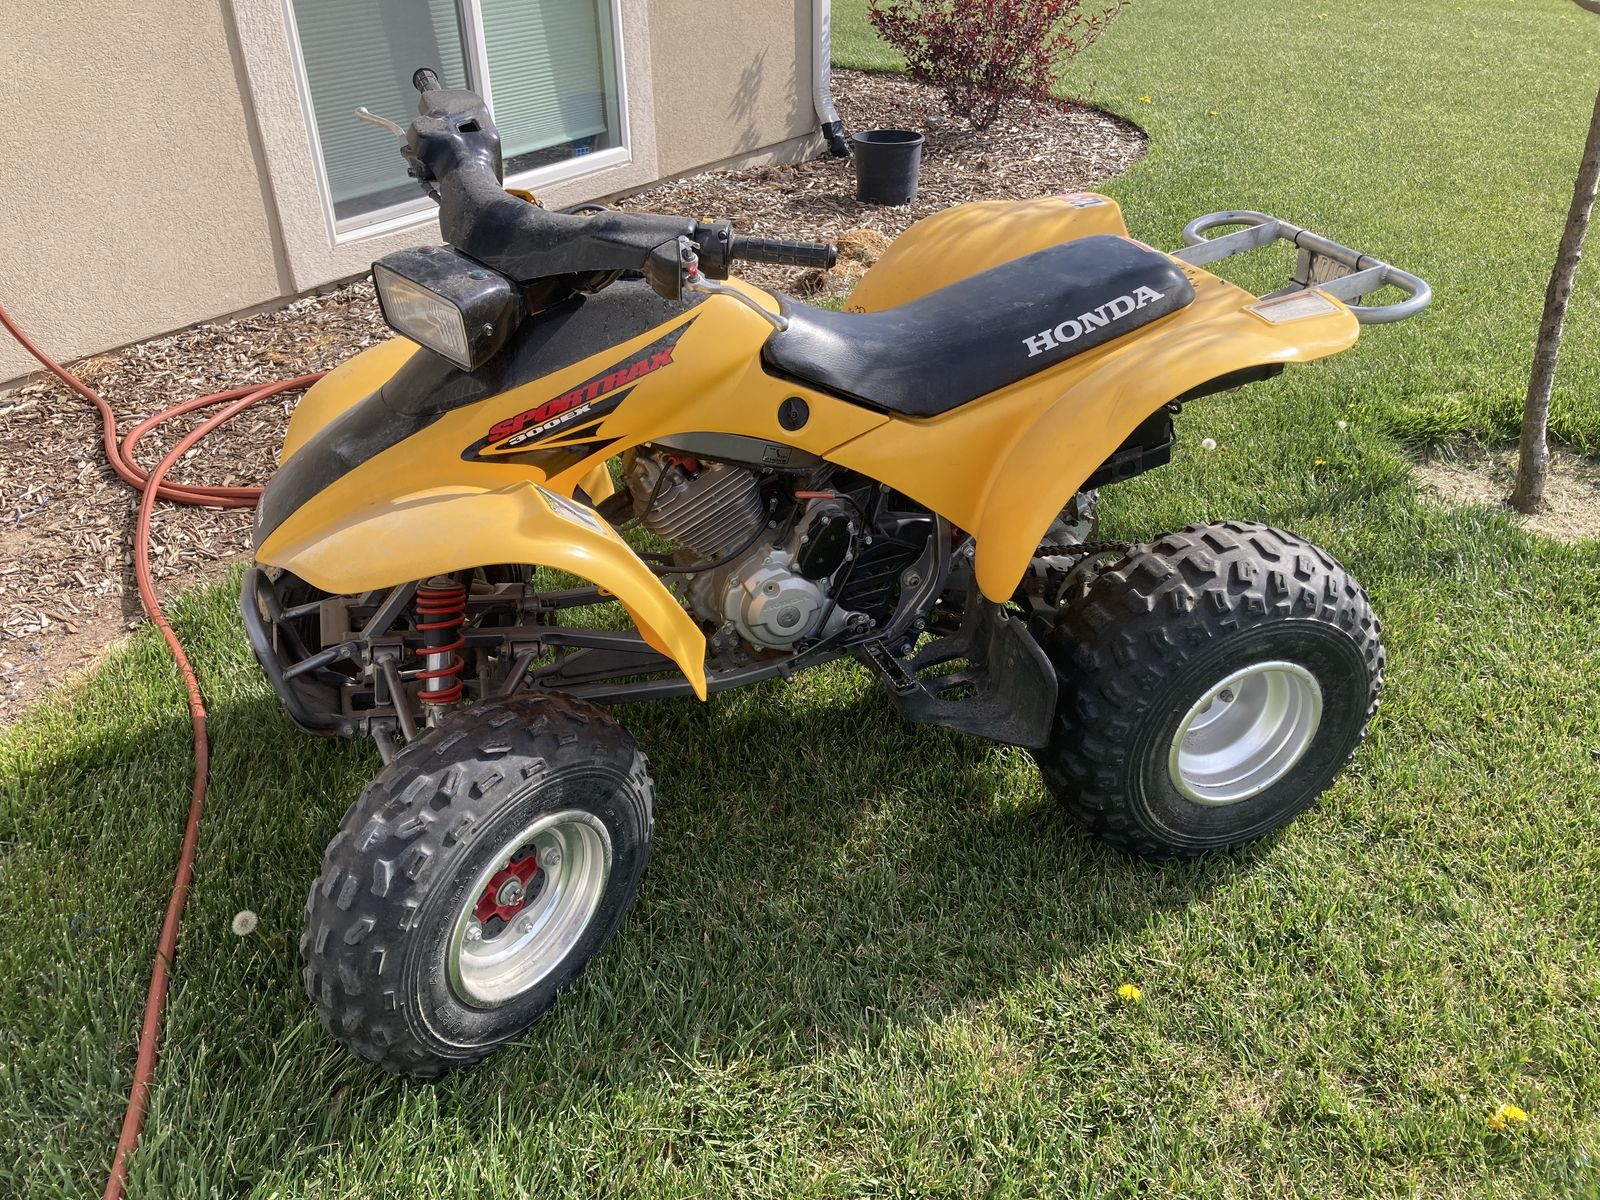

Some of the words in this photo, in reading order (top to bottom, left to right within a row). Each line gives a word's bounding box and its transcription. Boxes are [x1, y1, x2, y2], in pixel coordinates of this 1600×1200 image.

[1022, 285, 1165, 357] HONDA
[488, 346, 674, 442] SPORTRAX
[508, 403, 592, 446] 300EX
